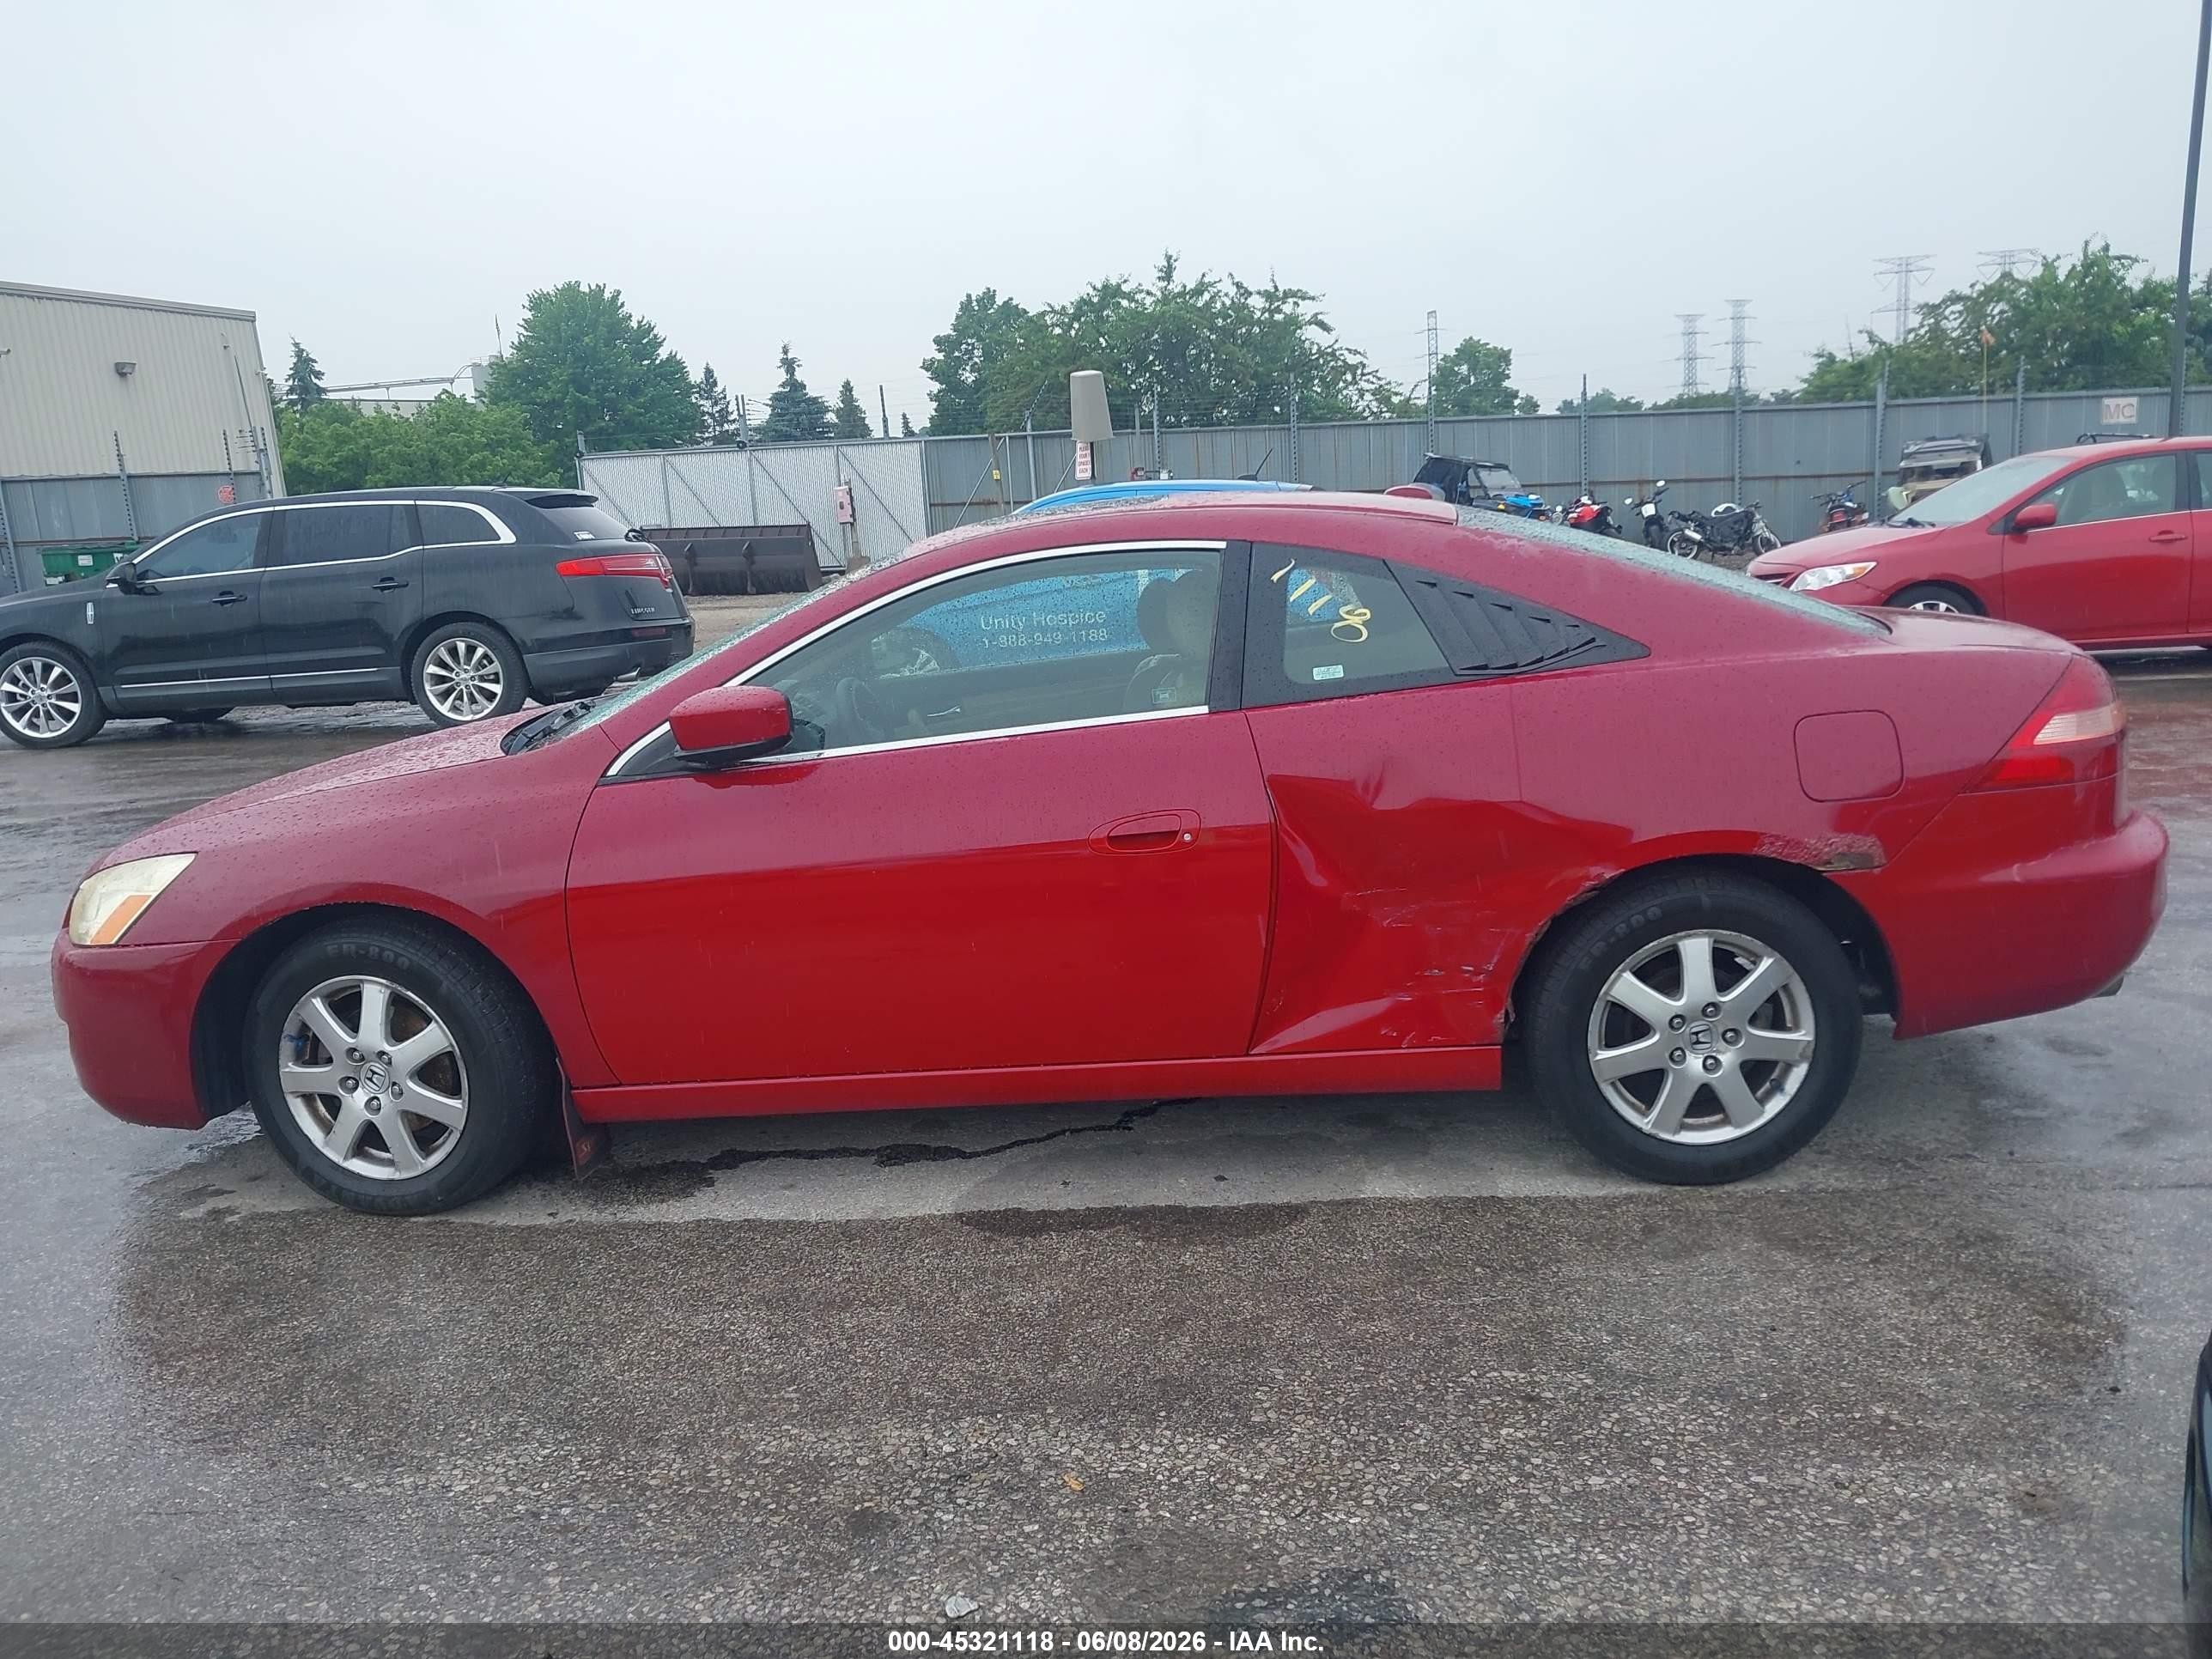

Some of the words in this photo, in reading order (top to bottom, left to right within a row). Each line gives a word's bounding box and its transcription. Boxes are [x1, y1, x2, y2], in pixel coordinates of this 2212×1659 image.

[2105, 403, 2135, 419] MC
[981, 614, 1026, 632] Unity
[1032, 609, 1107, 627] Hospice
